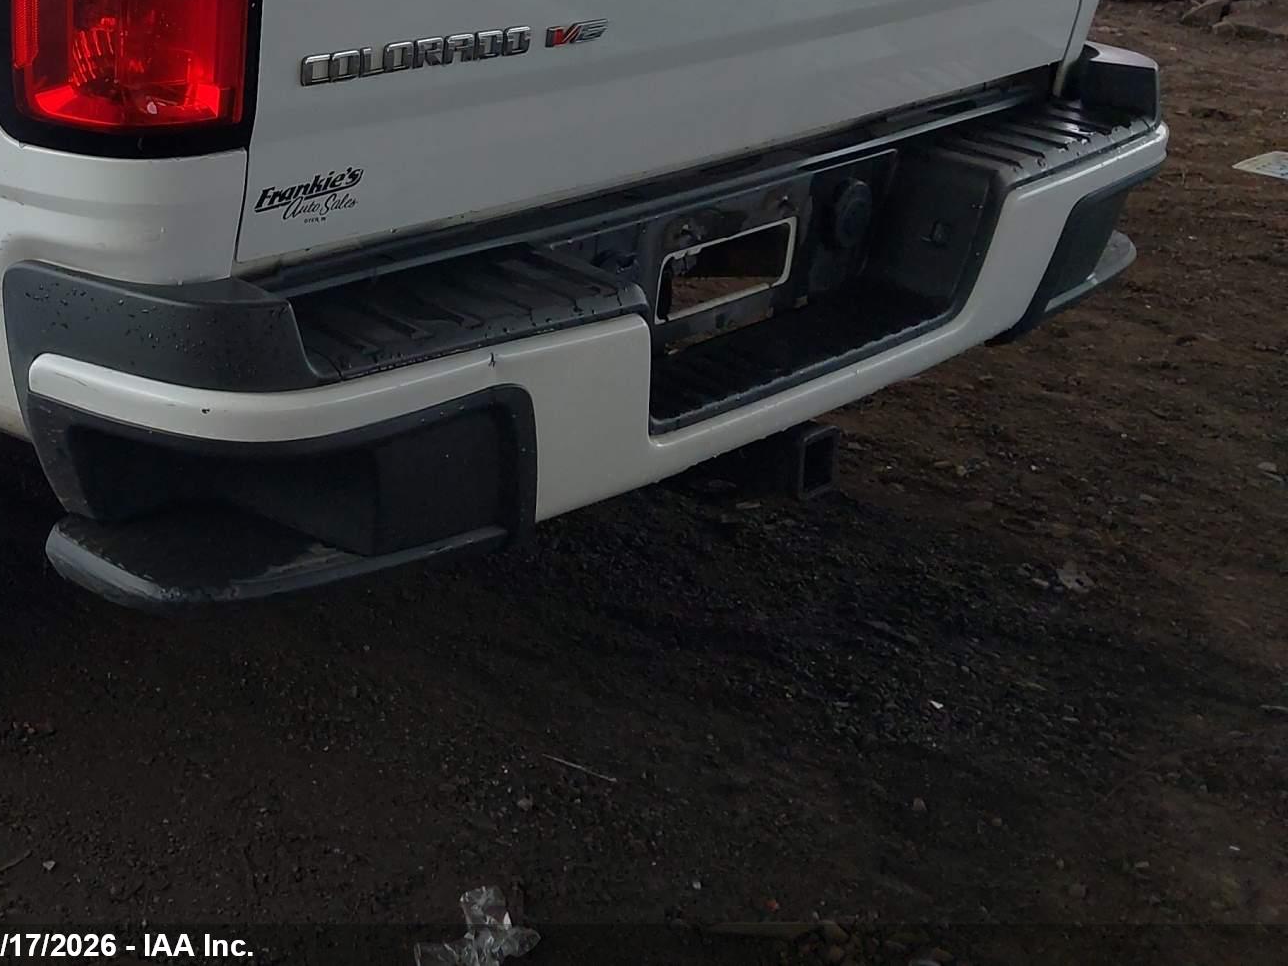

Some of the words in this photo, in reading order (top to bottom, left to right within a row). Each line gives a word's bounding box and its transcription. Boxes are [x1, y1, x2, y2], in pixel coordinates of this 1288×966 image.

[300, 25, 531, 87] COLORADO
[544, 17, 609, 49] V6
[254, 166, 365, 212] Frankie's
[282, 195, 322, 221] Auto
[318, 192, 359, 216] Sales
